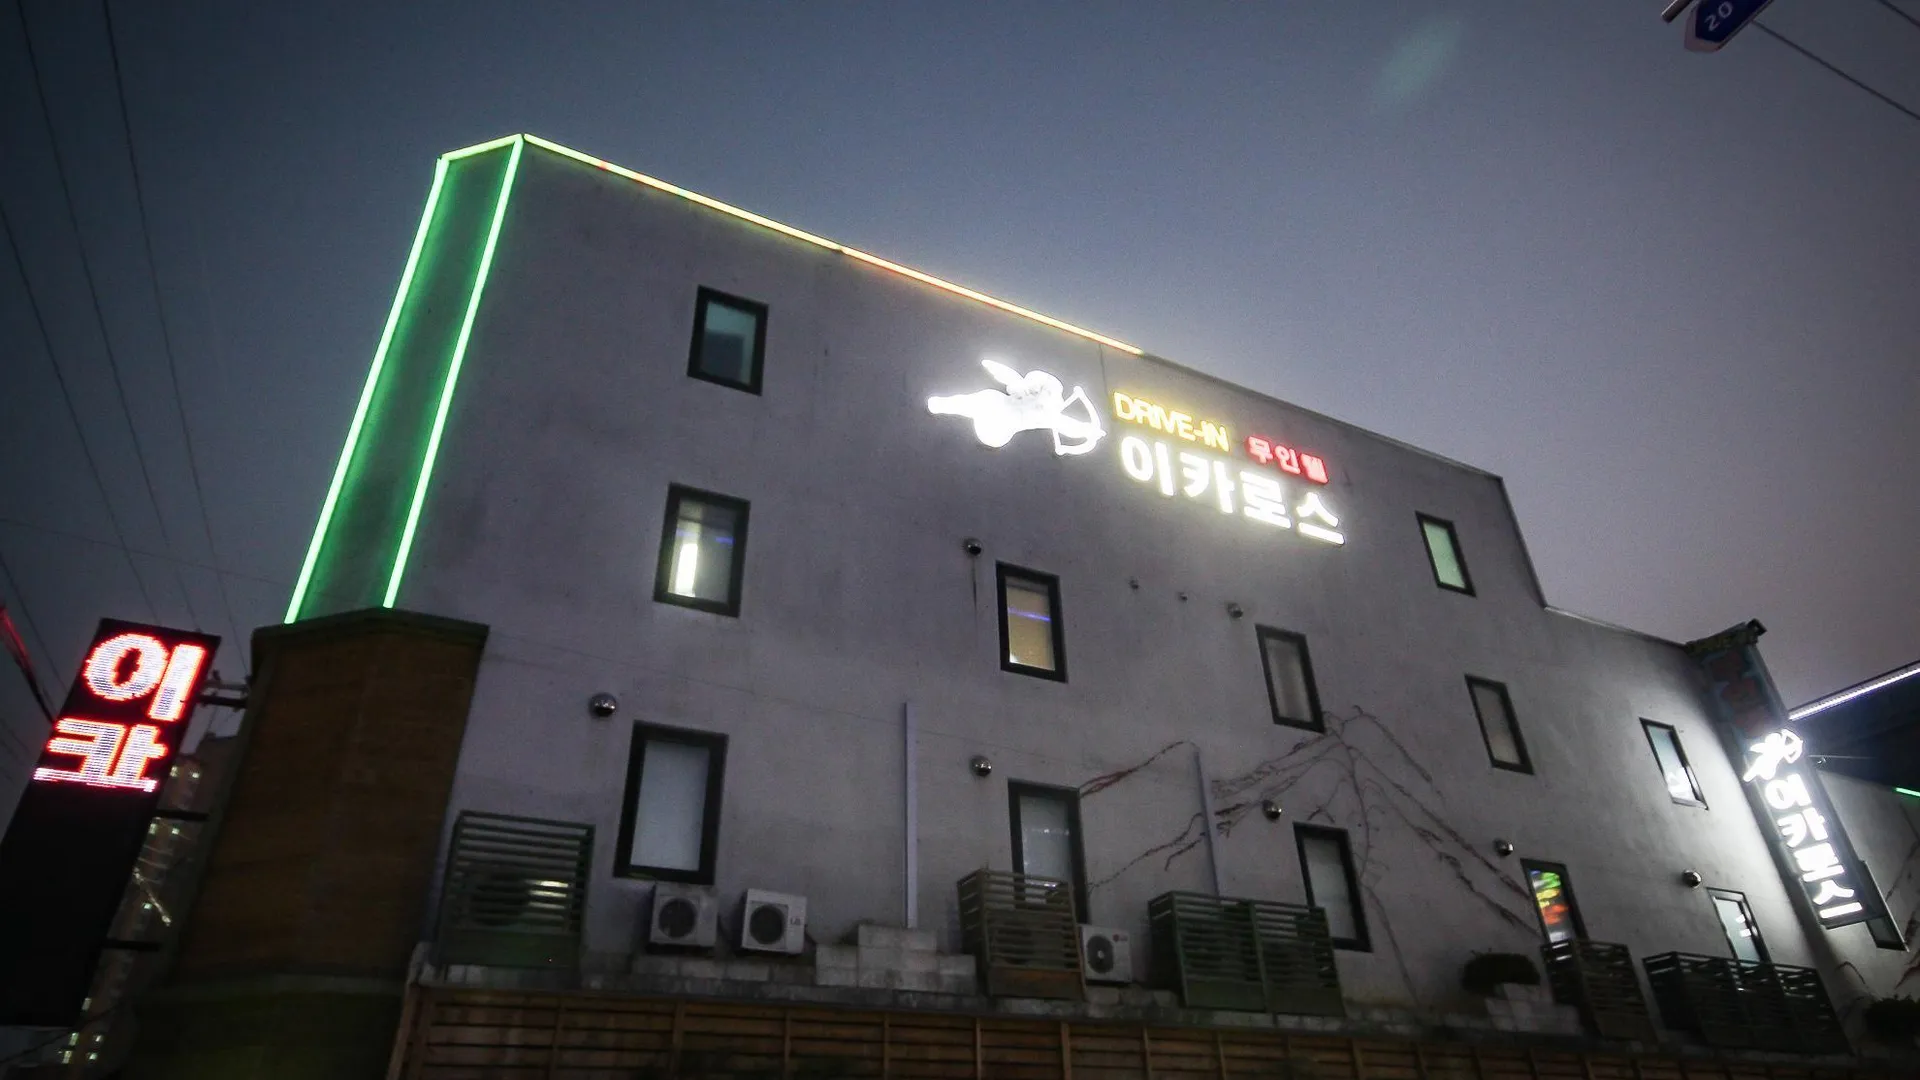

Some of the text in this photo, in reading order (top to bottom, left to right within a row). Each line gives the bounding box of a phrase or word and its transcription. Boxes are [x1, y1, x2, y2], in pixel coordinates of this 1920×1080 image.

[1704, 1, 1733, 32] 20
[1113, 391, 1231, 452] DRIVE-IN
[1119, 435, 1346, 546] 이카로스
[33, 632, 207, 793] 이카
